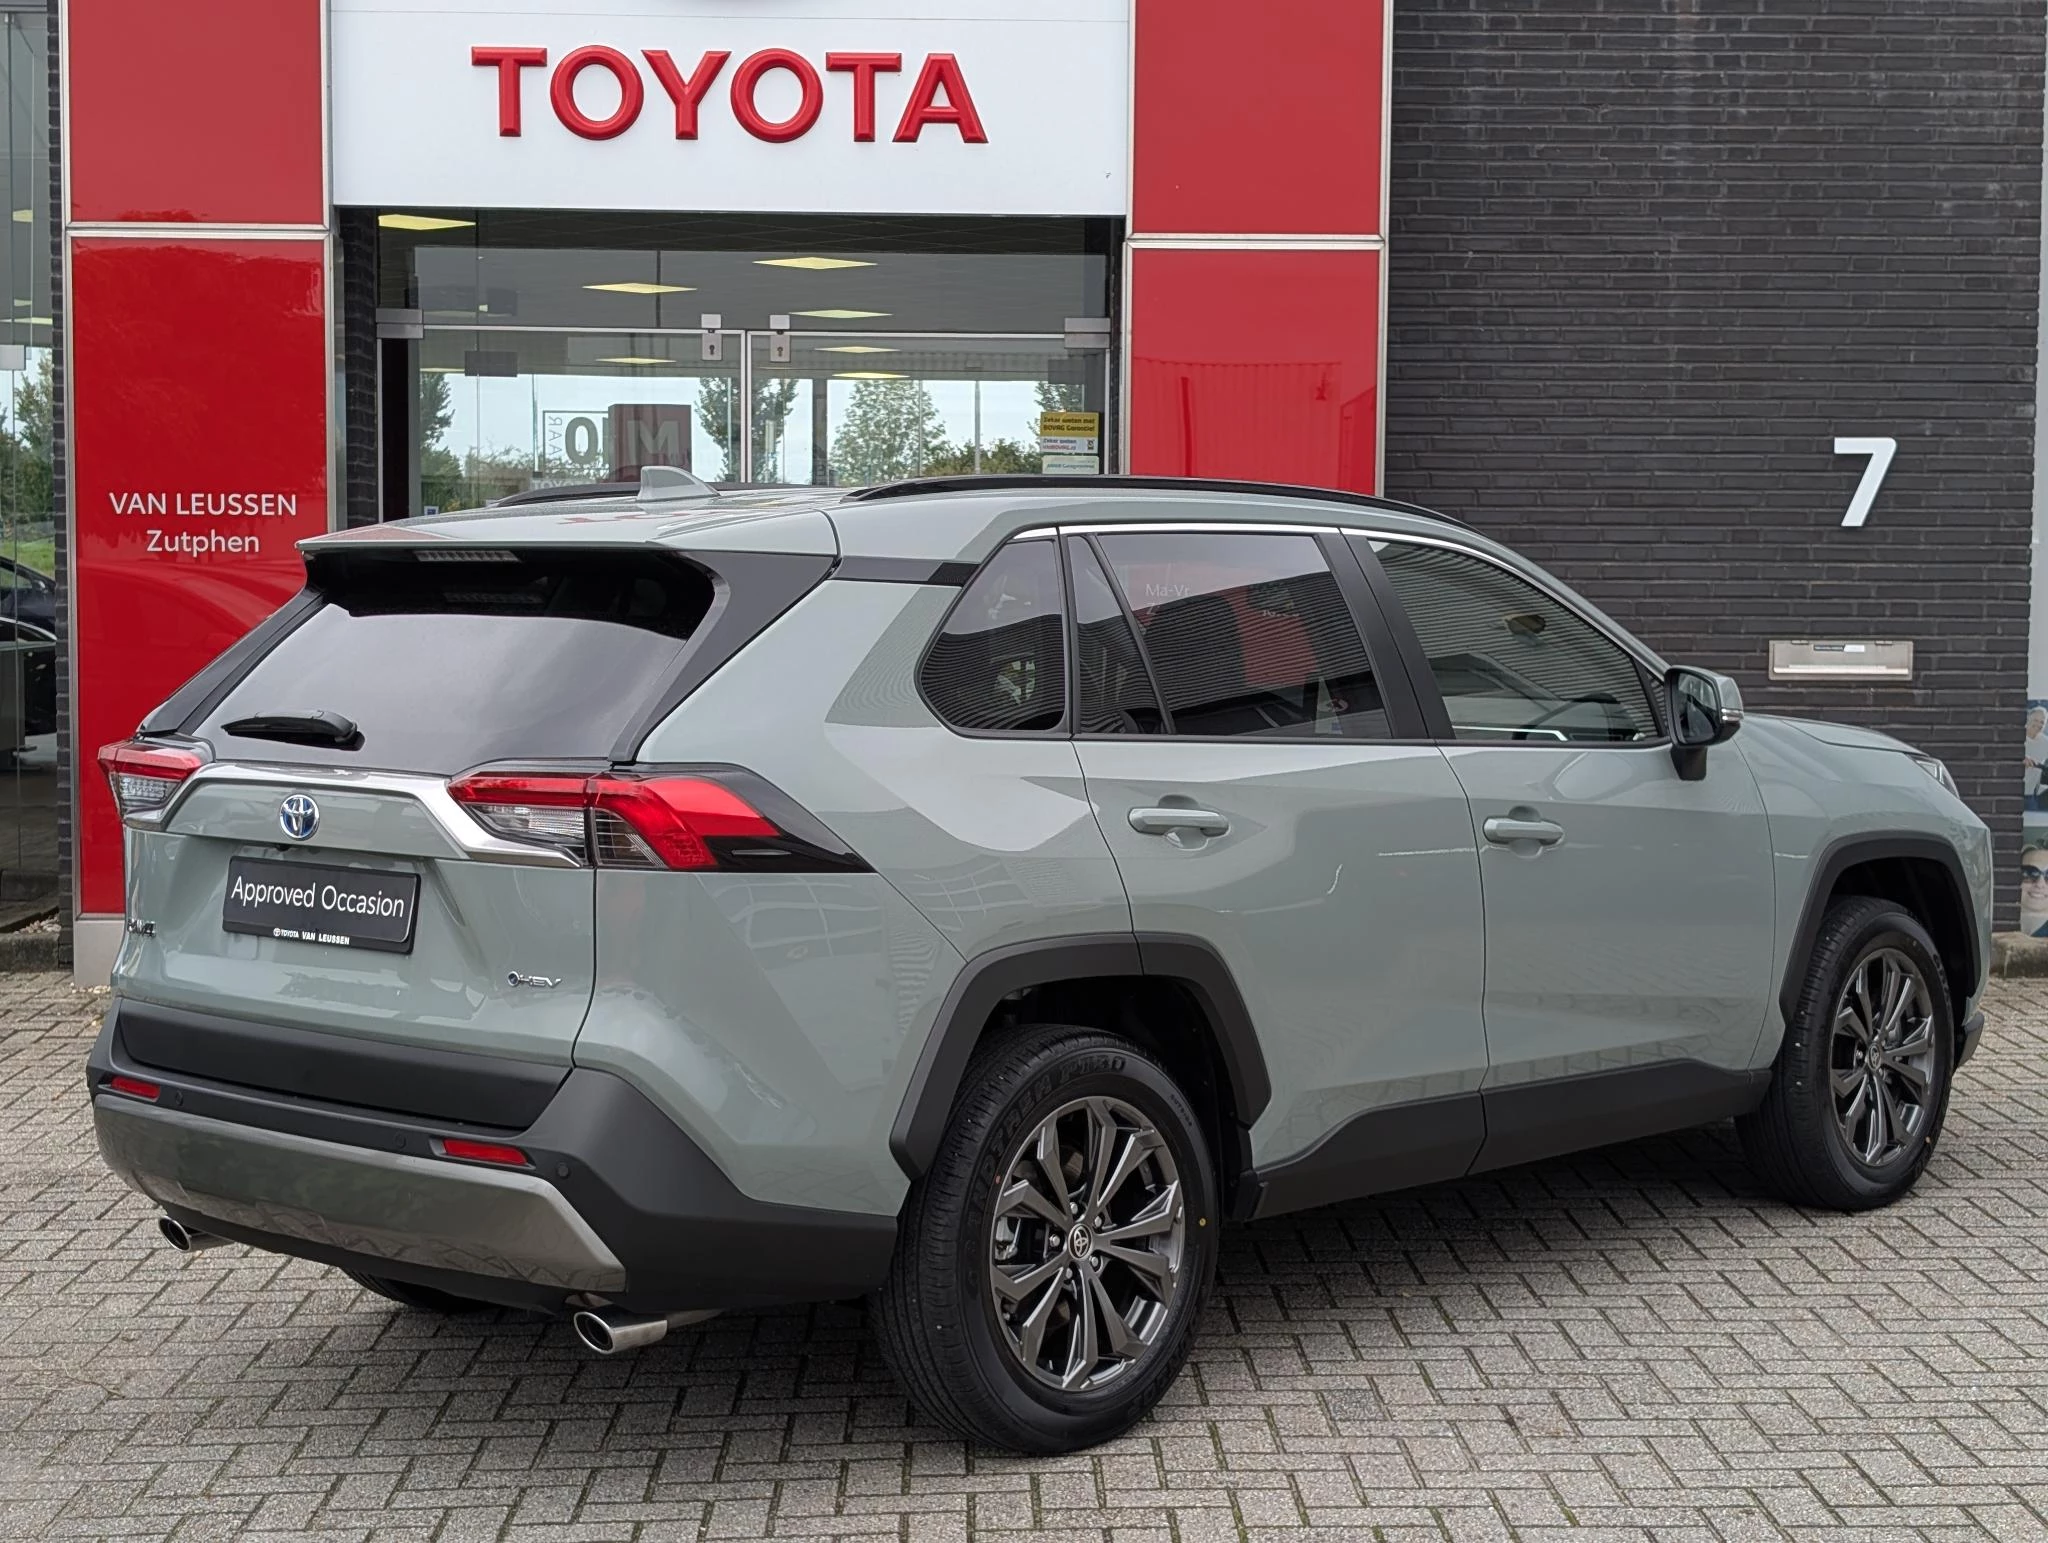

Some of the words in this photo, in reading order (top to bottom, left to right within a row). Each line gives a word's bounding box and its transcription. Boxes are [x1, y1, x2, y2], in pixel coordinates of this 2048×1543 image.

[471, 45, 989, 144] TOYOTA
[1834, 437, 1897, 528] 7
[109, 493, 167, 515] VAN
[176, 493, 297, 516] LEUSSEN
[147, 529, 260, 558] Zutphen
[231, 875, 316, 908] Approved
[321, 885, 404, 917] Occasion
[281, 929, 299, 938] TOYOTA
[302, 931, 316, 941] VAN
[318, 933, 350, 945] LEUSSEN
